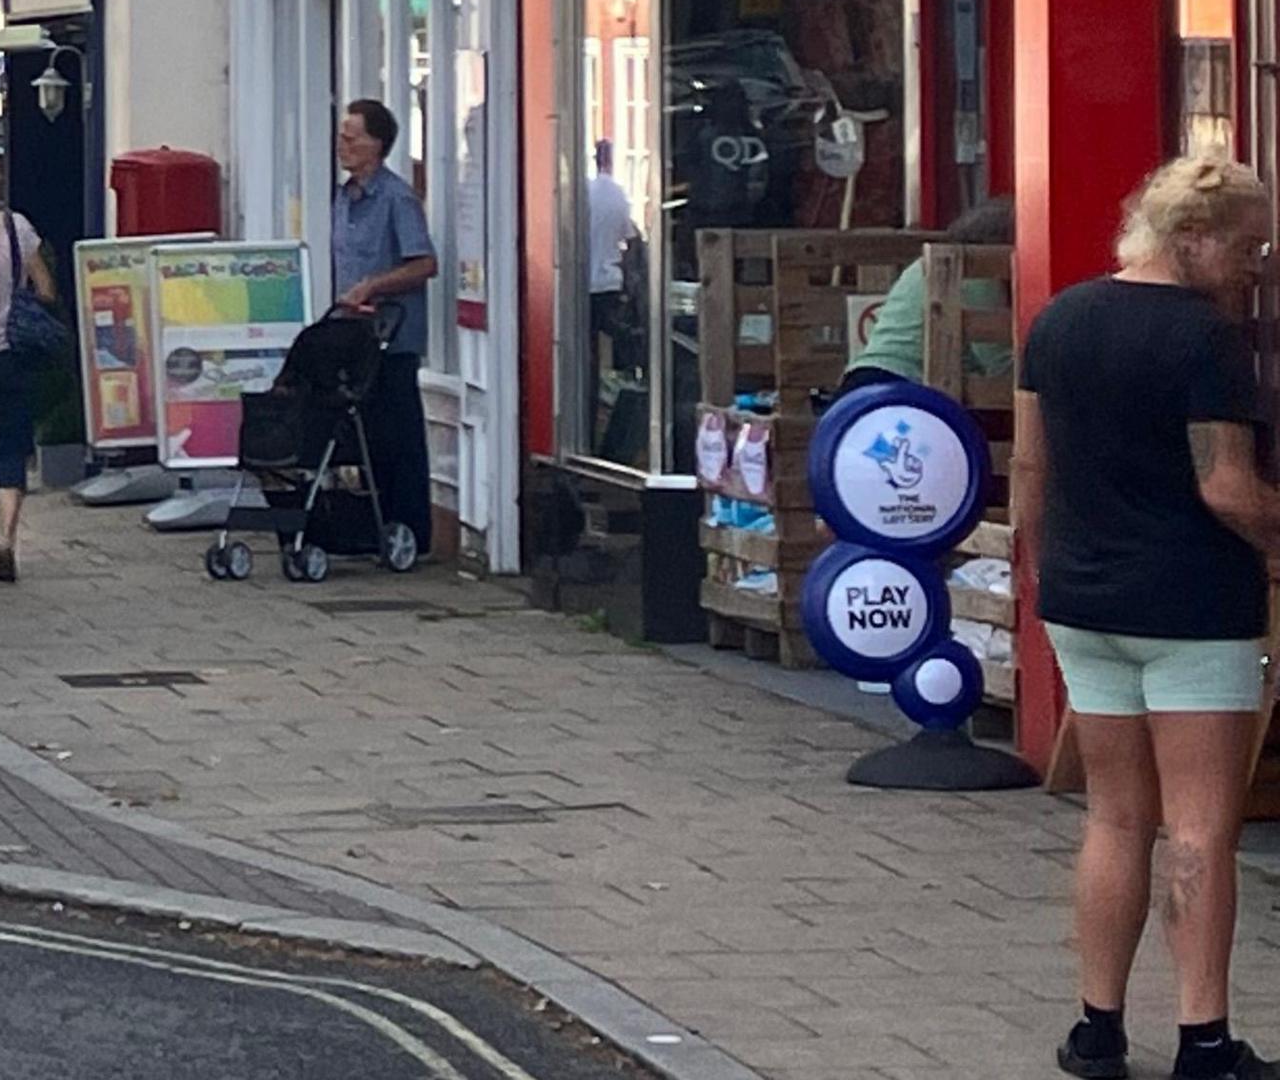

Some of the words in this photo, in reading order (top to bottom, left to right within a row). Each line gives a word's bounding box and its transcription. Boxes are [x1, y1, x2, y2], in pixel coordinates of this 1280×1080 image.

[712, 135, 769, 171] QD
[229, 260, 299, 276] SCHOOL
[897, 493, 920, 503] THE
[879, 504, 937, 514] NATIONAL
[846, 586, 911, 607] PLAY
[848, 608, 913, 630] NOW
